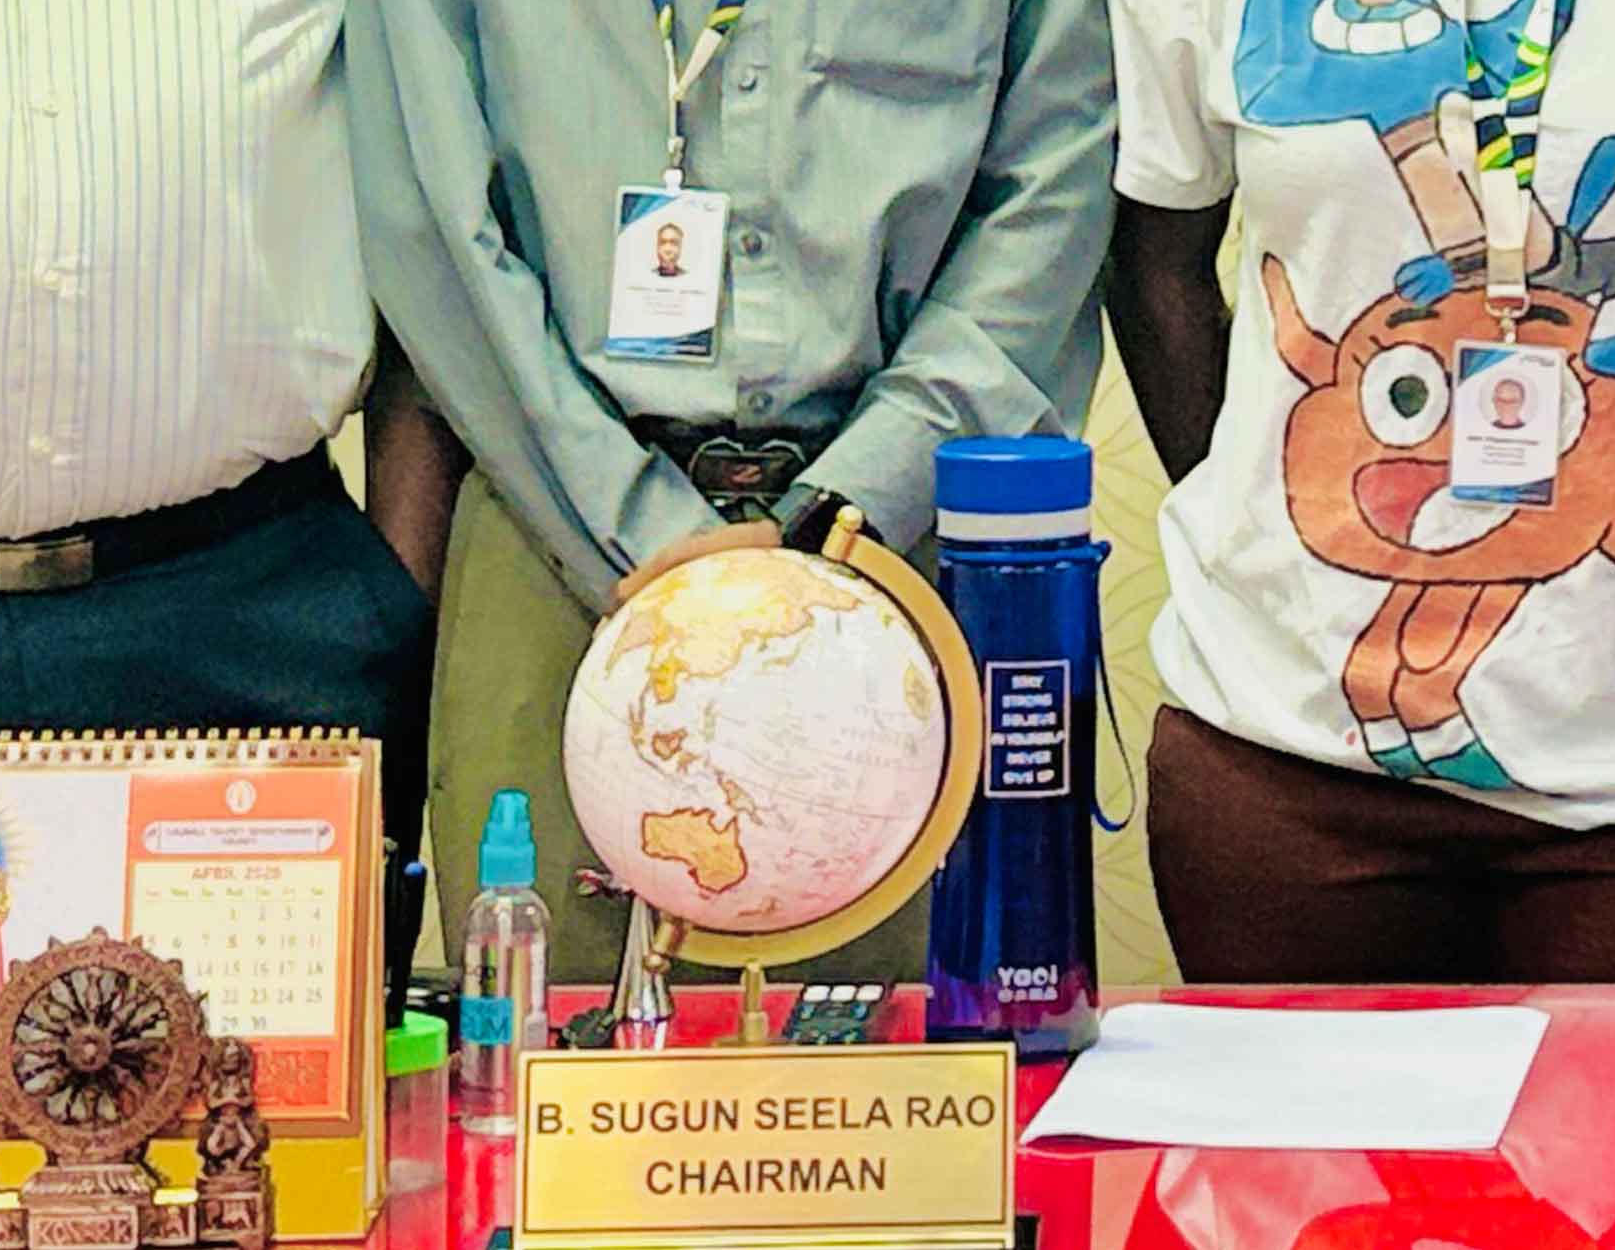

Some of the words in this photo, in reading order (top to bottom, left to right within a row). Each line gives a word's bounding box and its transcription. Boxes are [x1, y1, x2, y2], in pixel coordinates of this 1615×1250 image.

[191, 866, 236, 880] APRIL
[537, 1103, 575, 1135] B.
[590, 1099, 739, 1135] SUGUN
[754, 1096, 893, 1130] SEELA
[906, 1093, 997, 1127] RAO
[646, 1158, 887, 1196] CHAIRMAN
